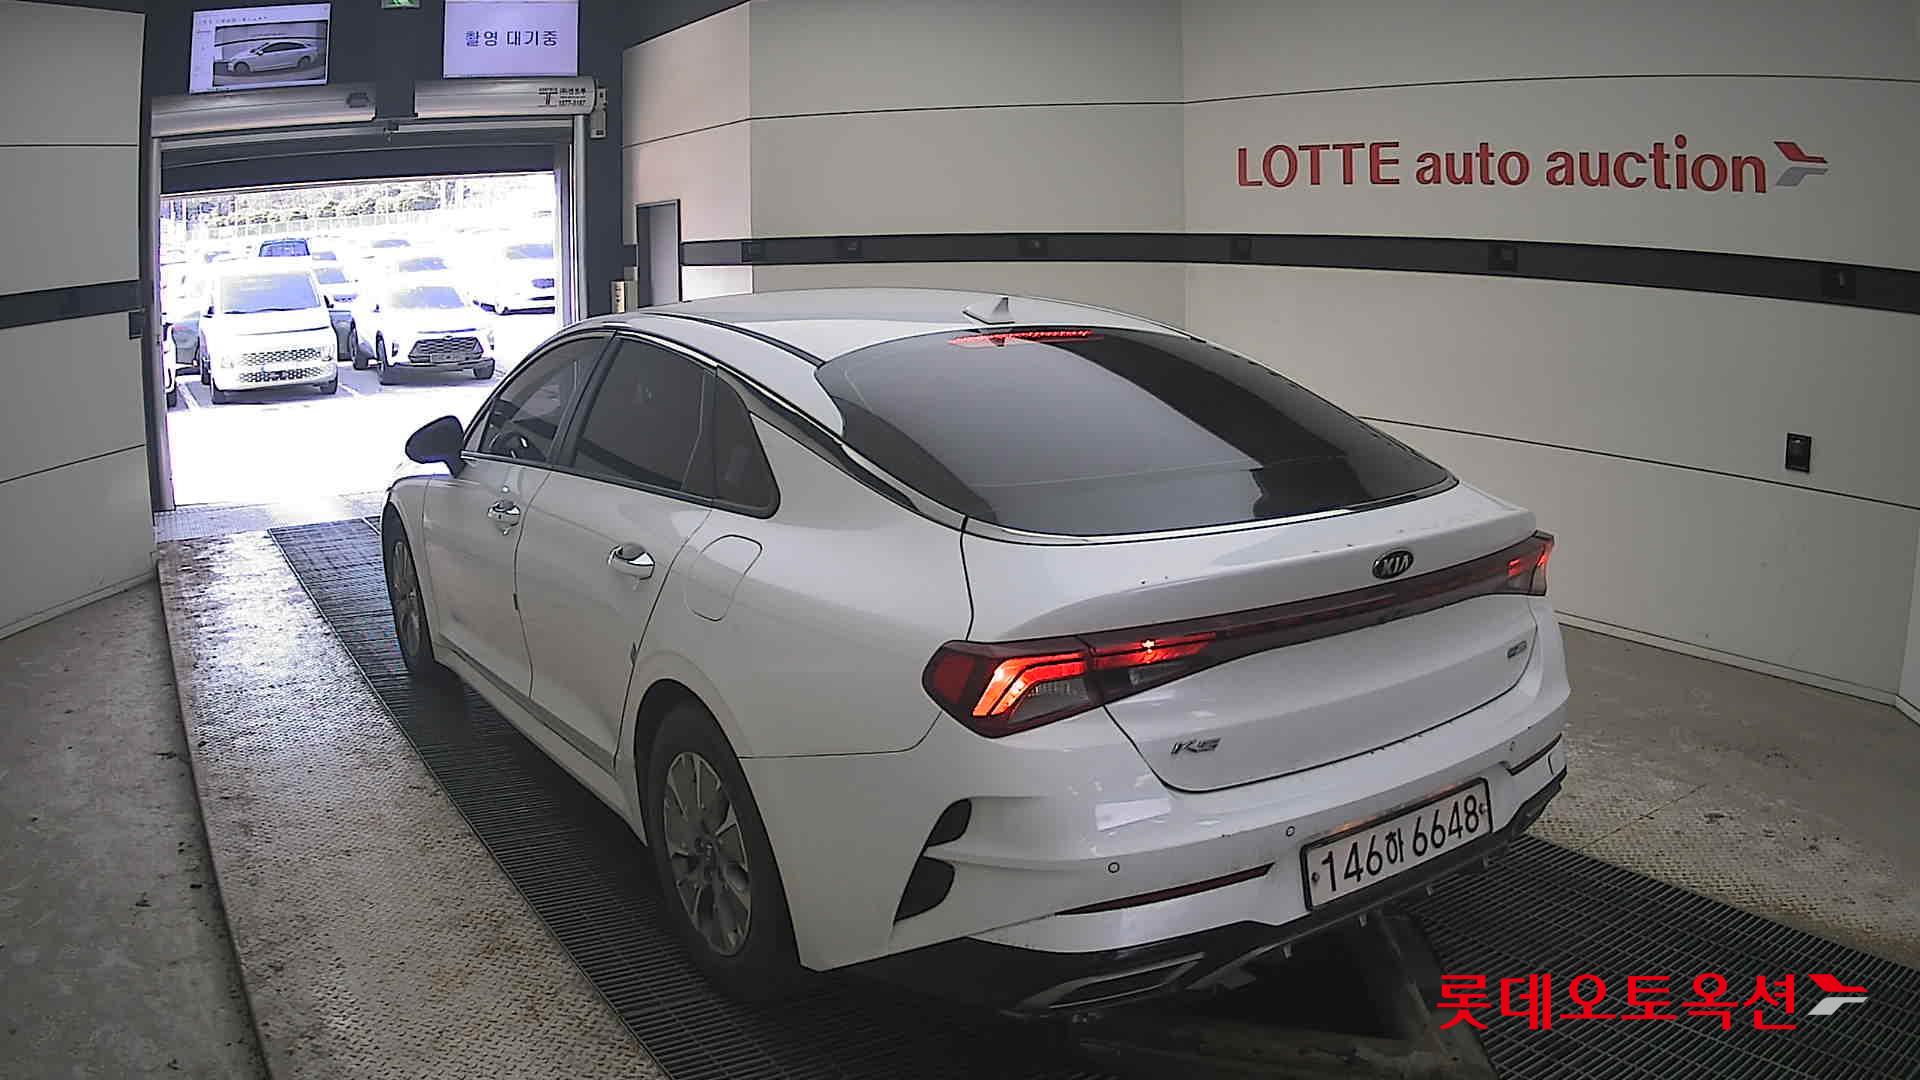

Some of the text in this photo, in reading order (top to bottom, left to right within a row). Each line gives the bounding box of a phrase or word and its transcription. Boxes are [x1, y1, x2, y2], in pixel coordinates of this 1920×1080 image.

[464, 30, 558, 47] 촬영 대기중
[1237, 133, 1768, 195] LOTTE auto auction
[1379, 553, 1411, 576] KIA
[1321, 794, 1481, 892] 146하 6648
